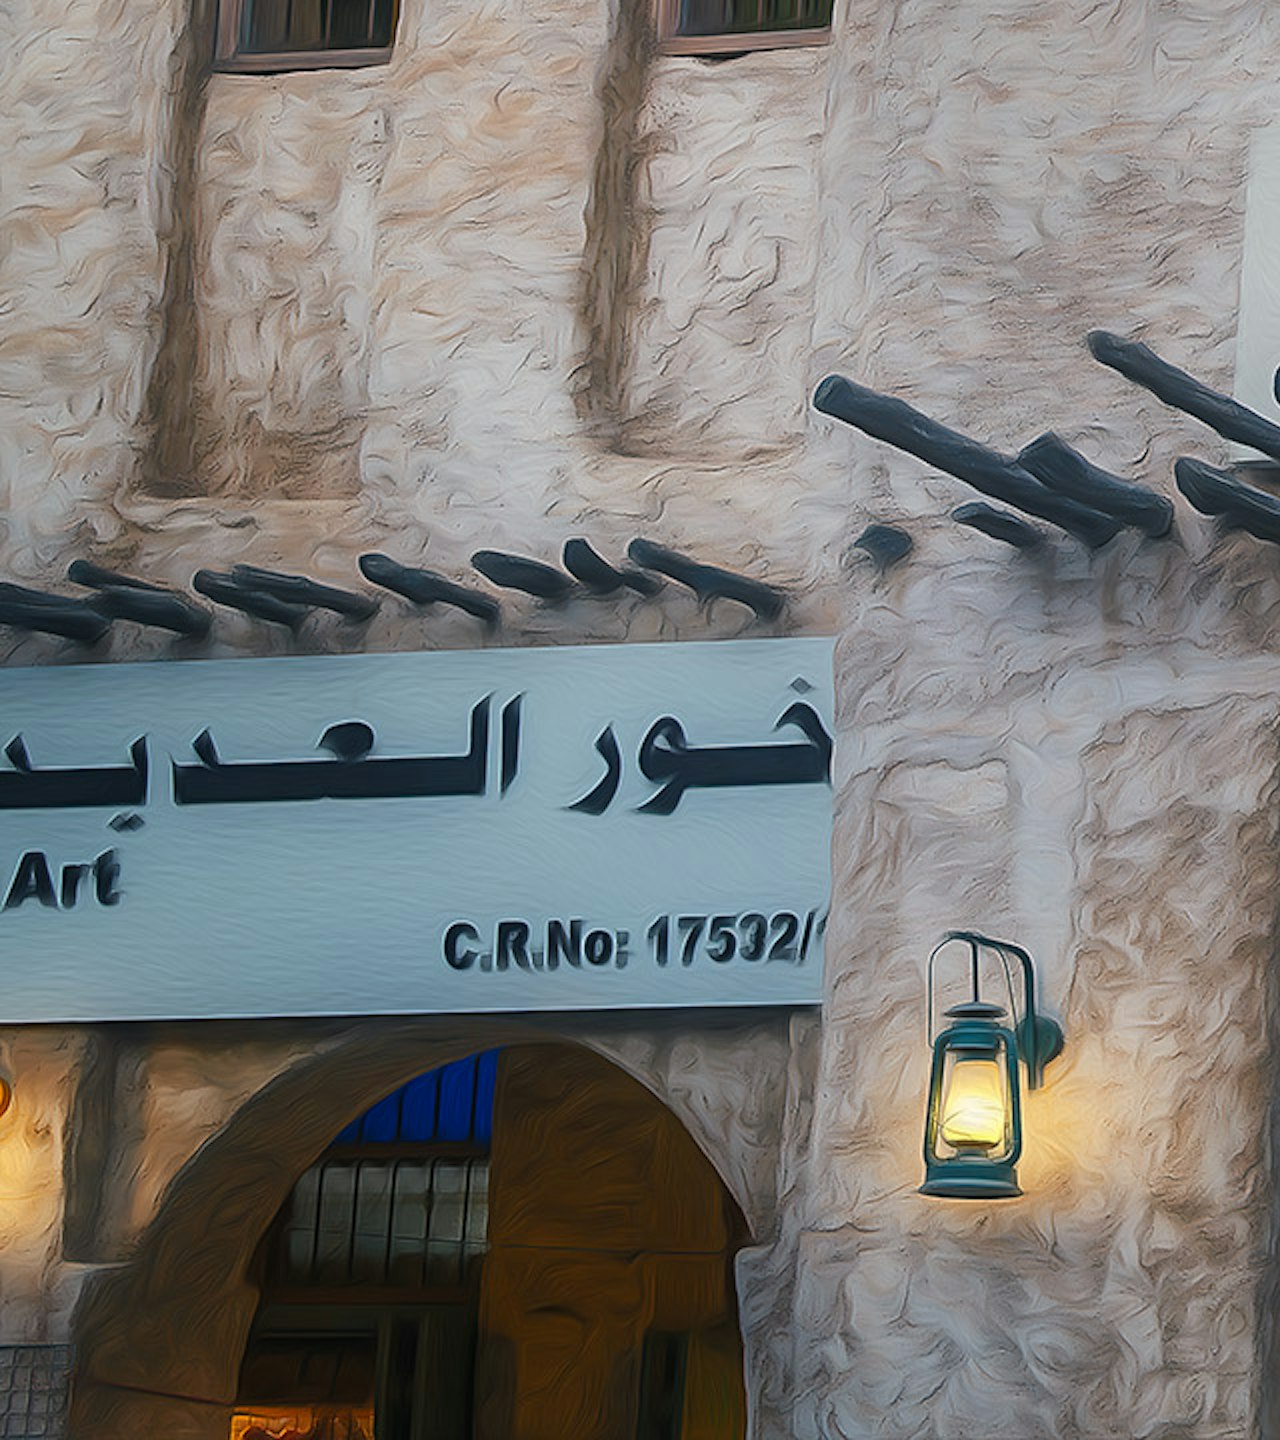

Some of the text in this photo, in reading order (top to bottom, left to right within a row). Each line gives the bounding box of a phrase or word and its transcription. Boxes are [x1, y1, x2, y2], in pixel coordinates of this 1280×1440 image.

[565, 676, 834, 816] خور
[4, 849, 122, 910] Art
[647, 910, 829, 966] 17532/
